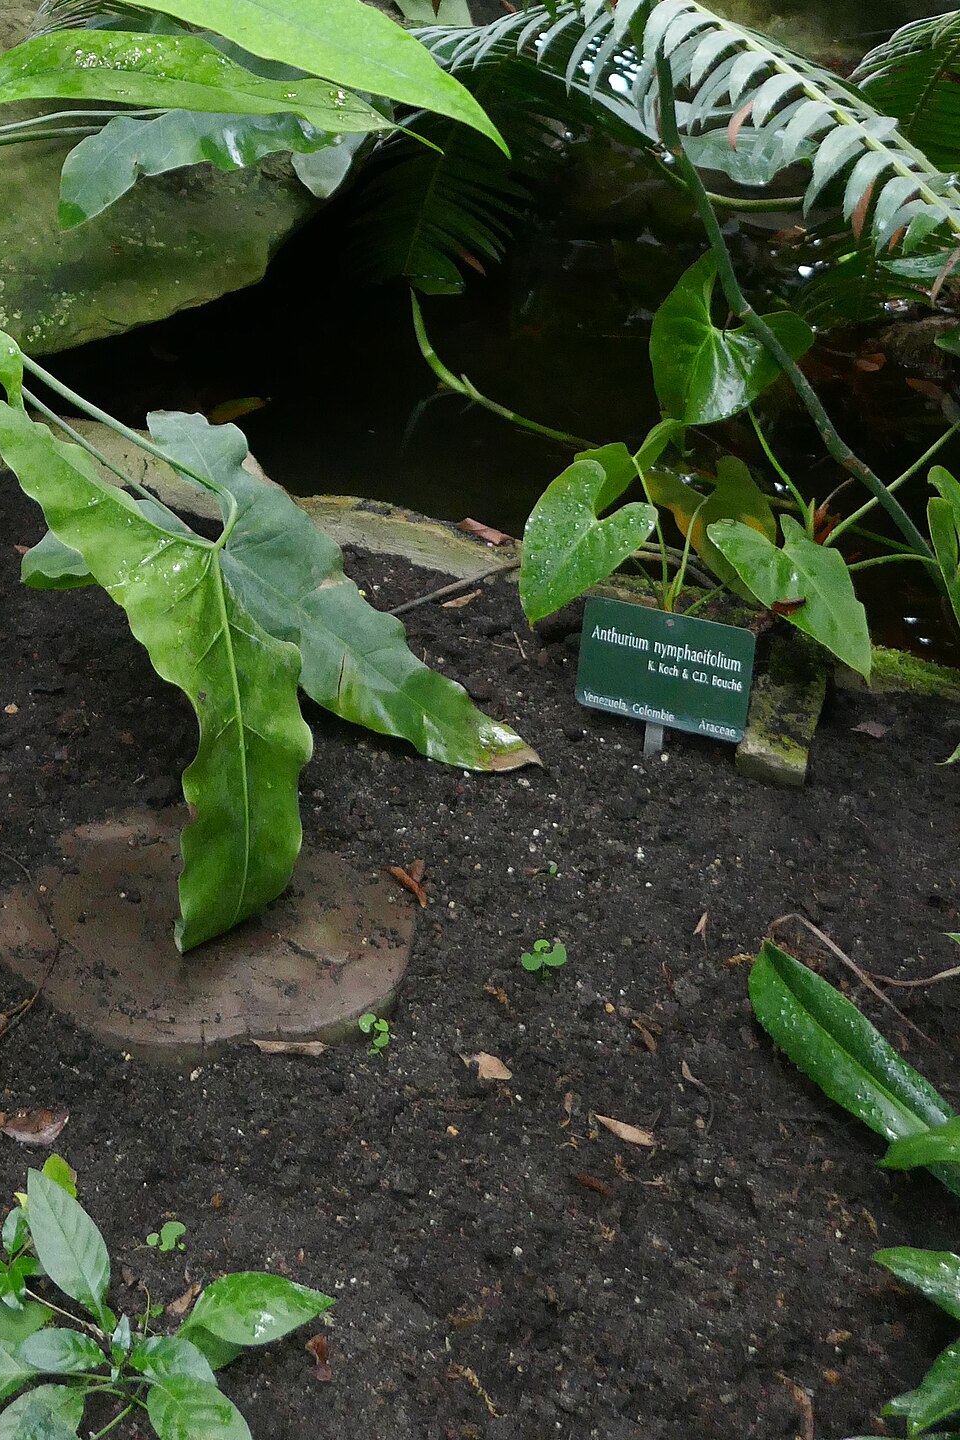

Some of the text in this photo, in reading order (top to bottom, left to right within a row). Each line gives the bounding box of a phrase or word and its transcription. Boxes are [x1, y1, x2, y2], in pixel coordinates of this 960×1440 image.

[591, 624, 741, 672] Anthurium nymphaeifolium
[647, 660, 656, 671] K.
[658, 662, 679, 677] Koch
[682, 668, 689, 680] &
[712, 675, 742, 692] Bouché
[632, 703, 675, 722] Colombie
[698, 720, 737, 737] Araceae
